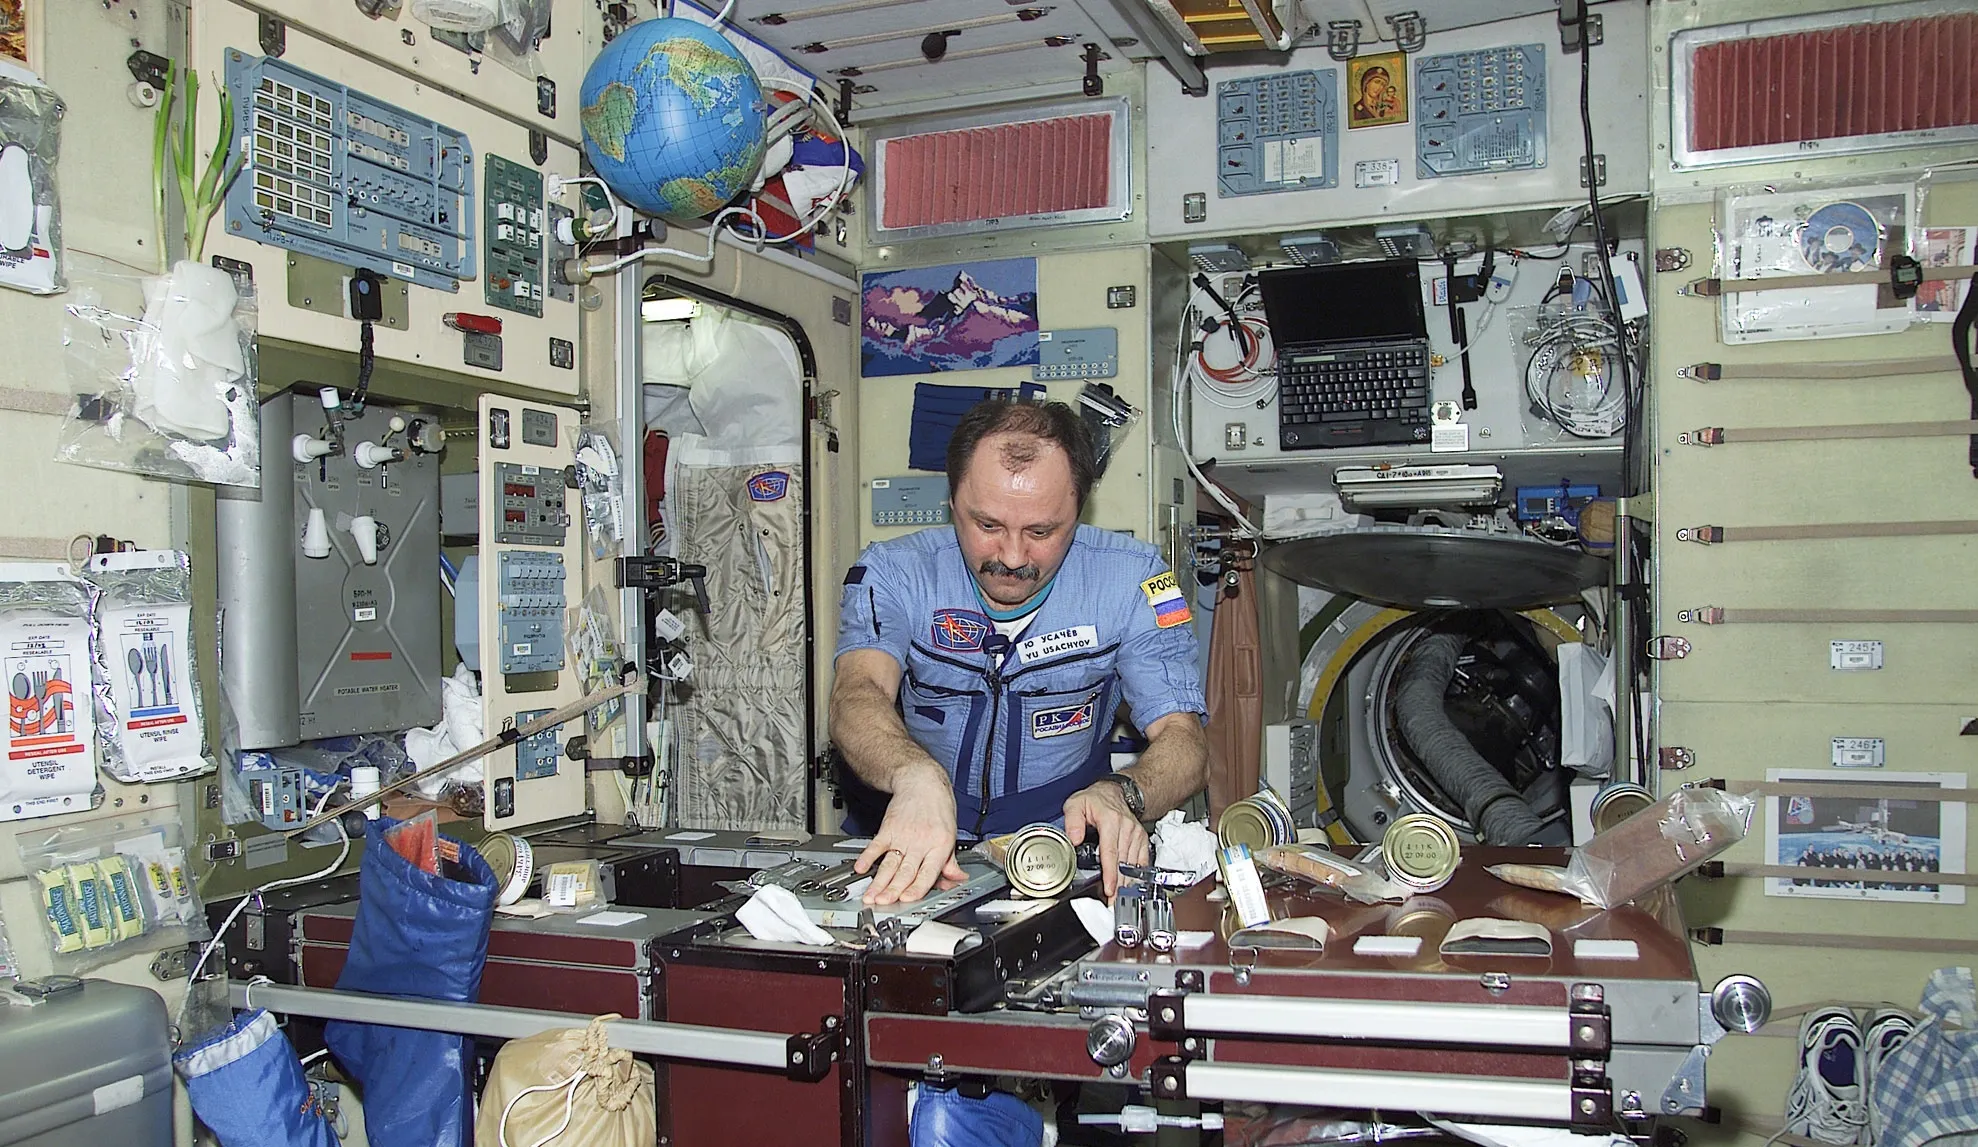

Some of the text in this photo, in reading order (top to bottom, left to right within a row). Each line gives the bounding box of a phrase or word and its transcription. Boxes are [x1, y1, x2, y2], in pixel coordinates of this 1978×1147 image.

[1024, 640, 1034, 649] Ю
[1849, 643, 1869, 651] 245
[1026, 639, 1090, 660] YU USACHYOV
[1850, 740, 1870, 749] 246
[27, 766, 65, 775] DETERGENT
